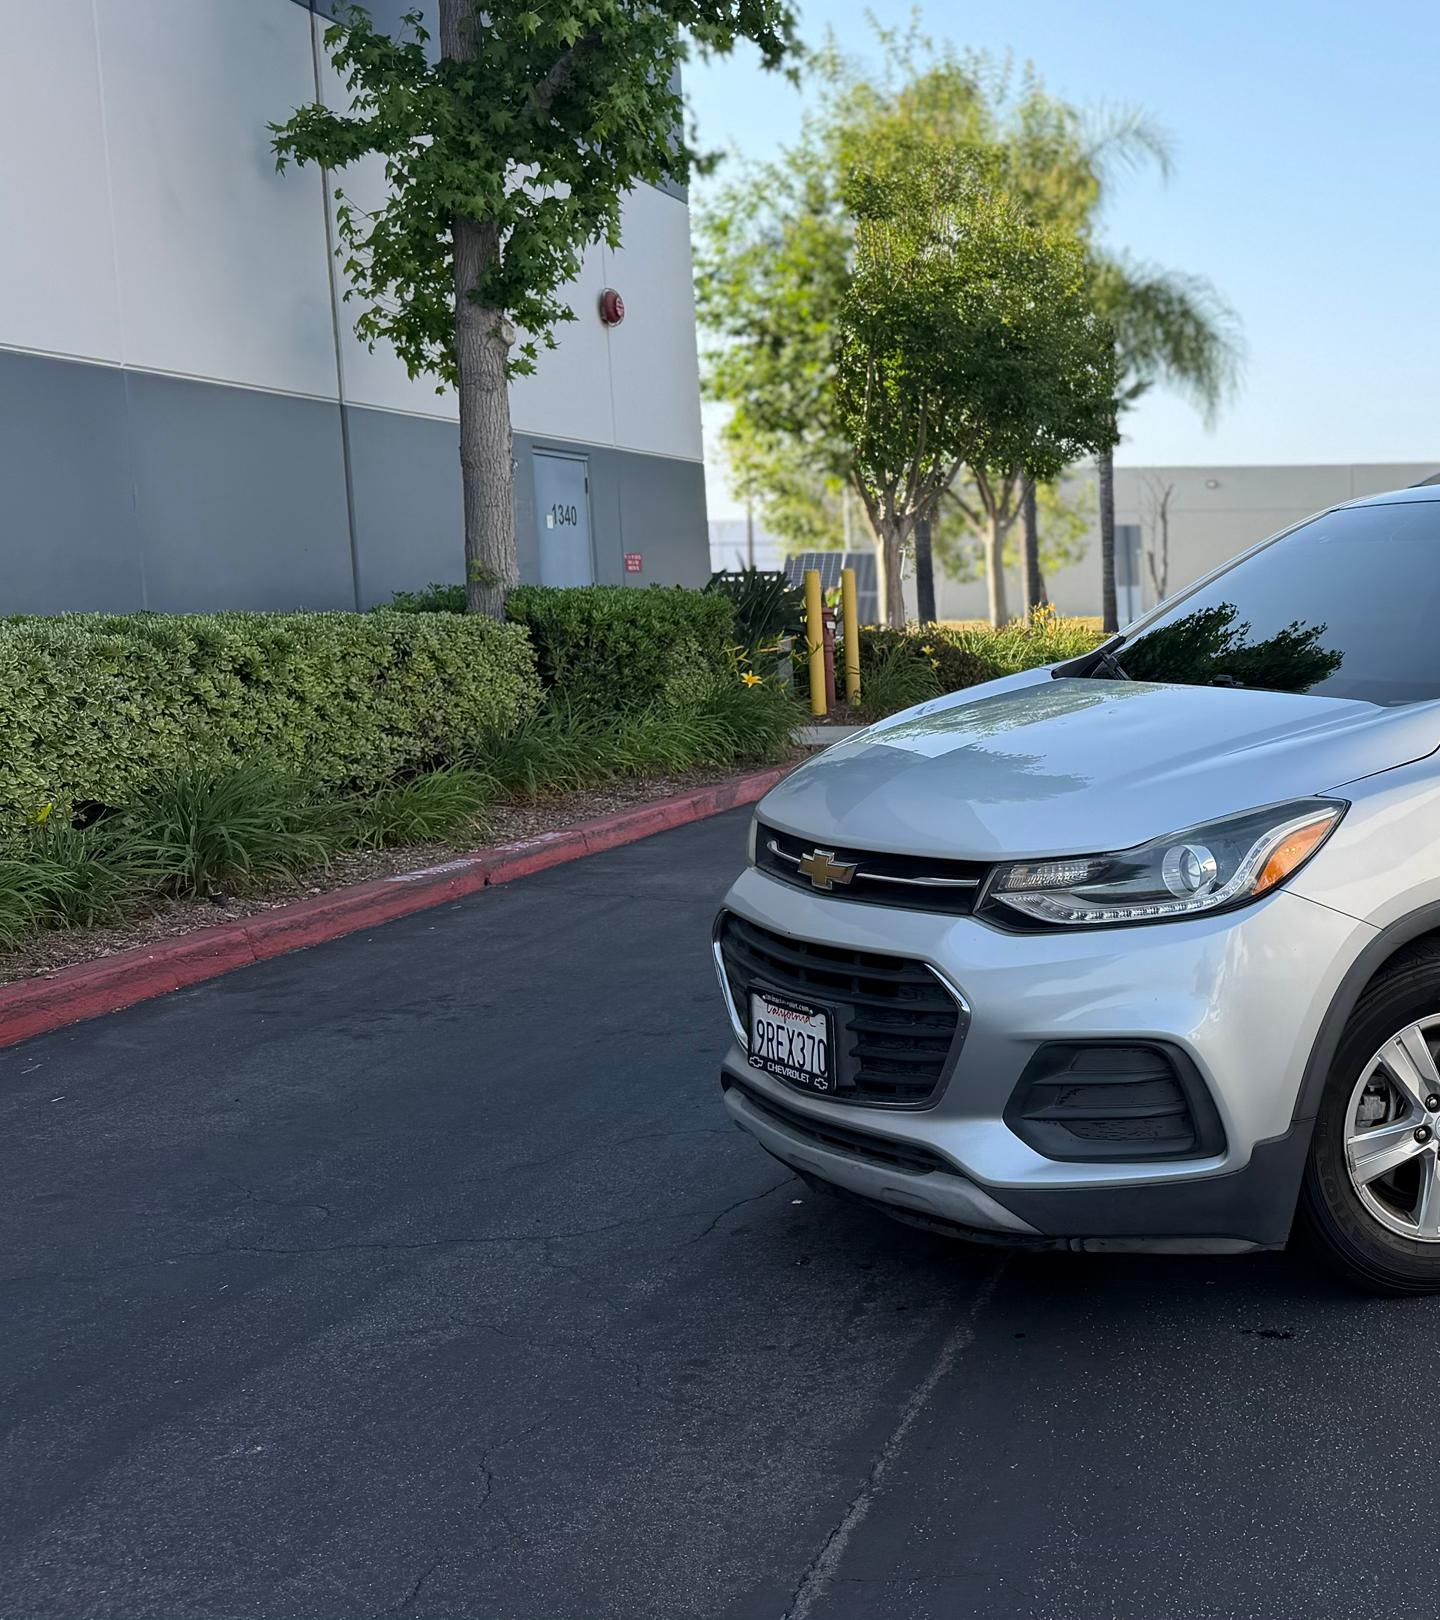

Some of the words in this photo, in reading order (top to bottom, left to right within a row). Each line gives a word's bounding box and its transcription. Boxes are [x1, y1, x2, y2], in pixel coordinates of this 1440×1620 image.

[552, 504, 577, 526] 1340
[756, 1018, 828, 1075] 9REX370
[767, 1061, 810, 1083] CHEVROLET
